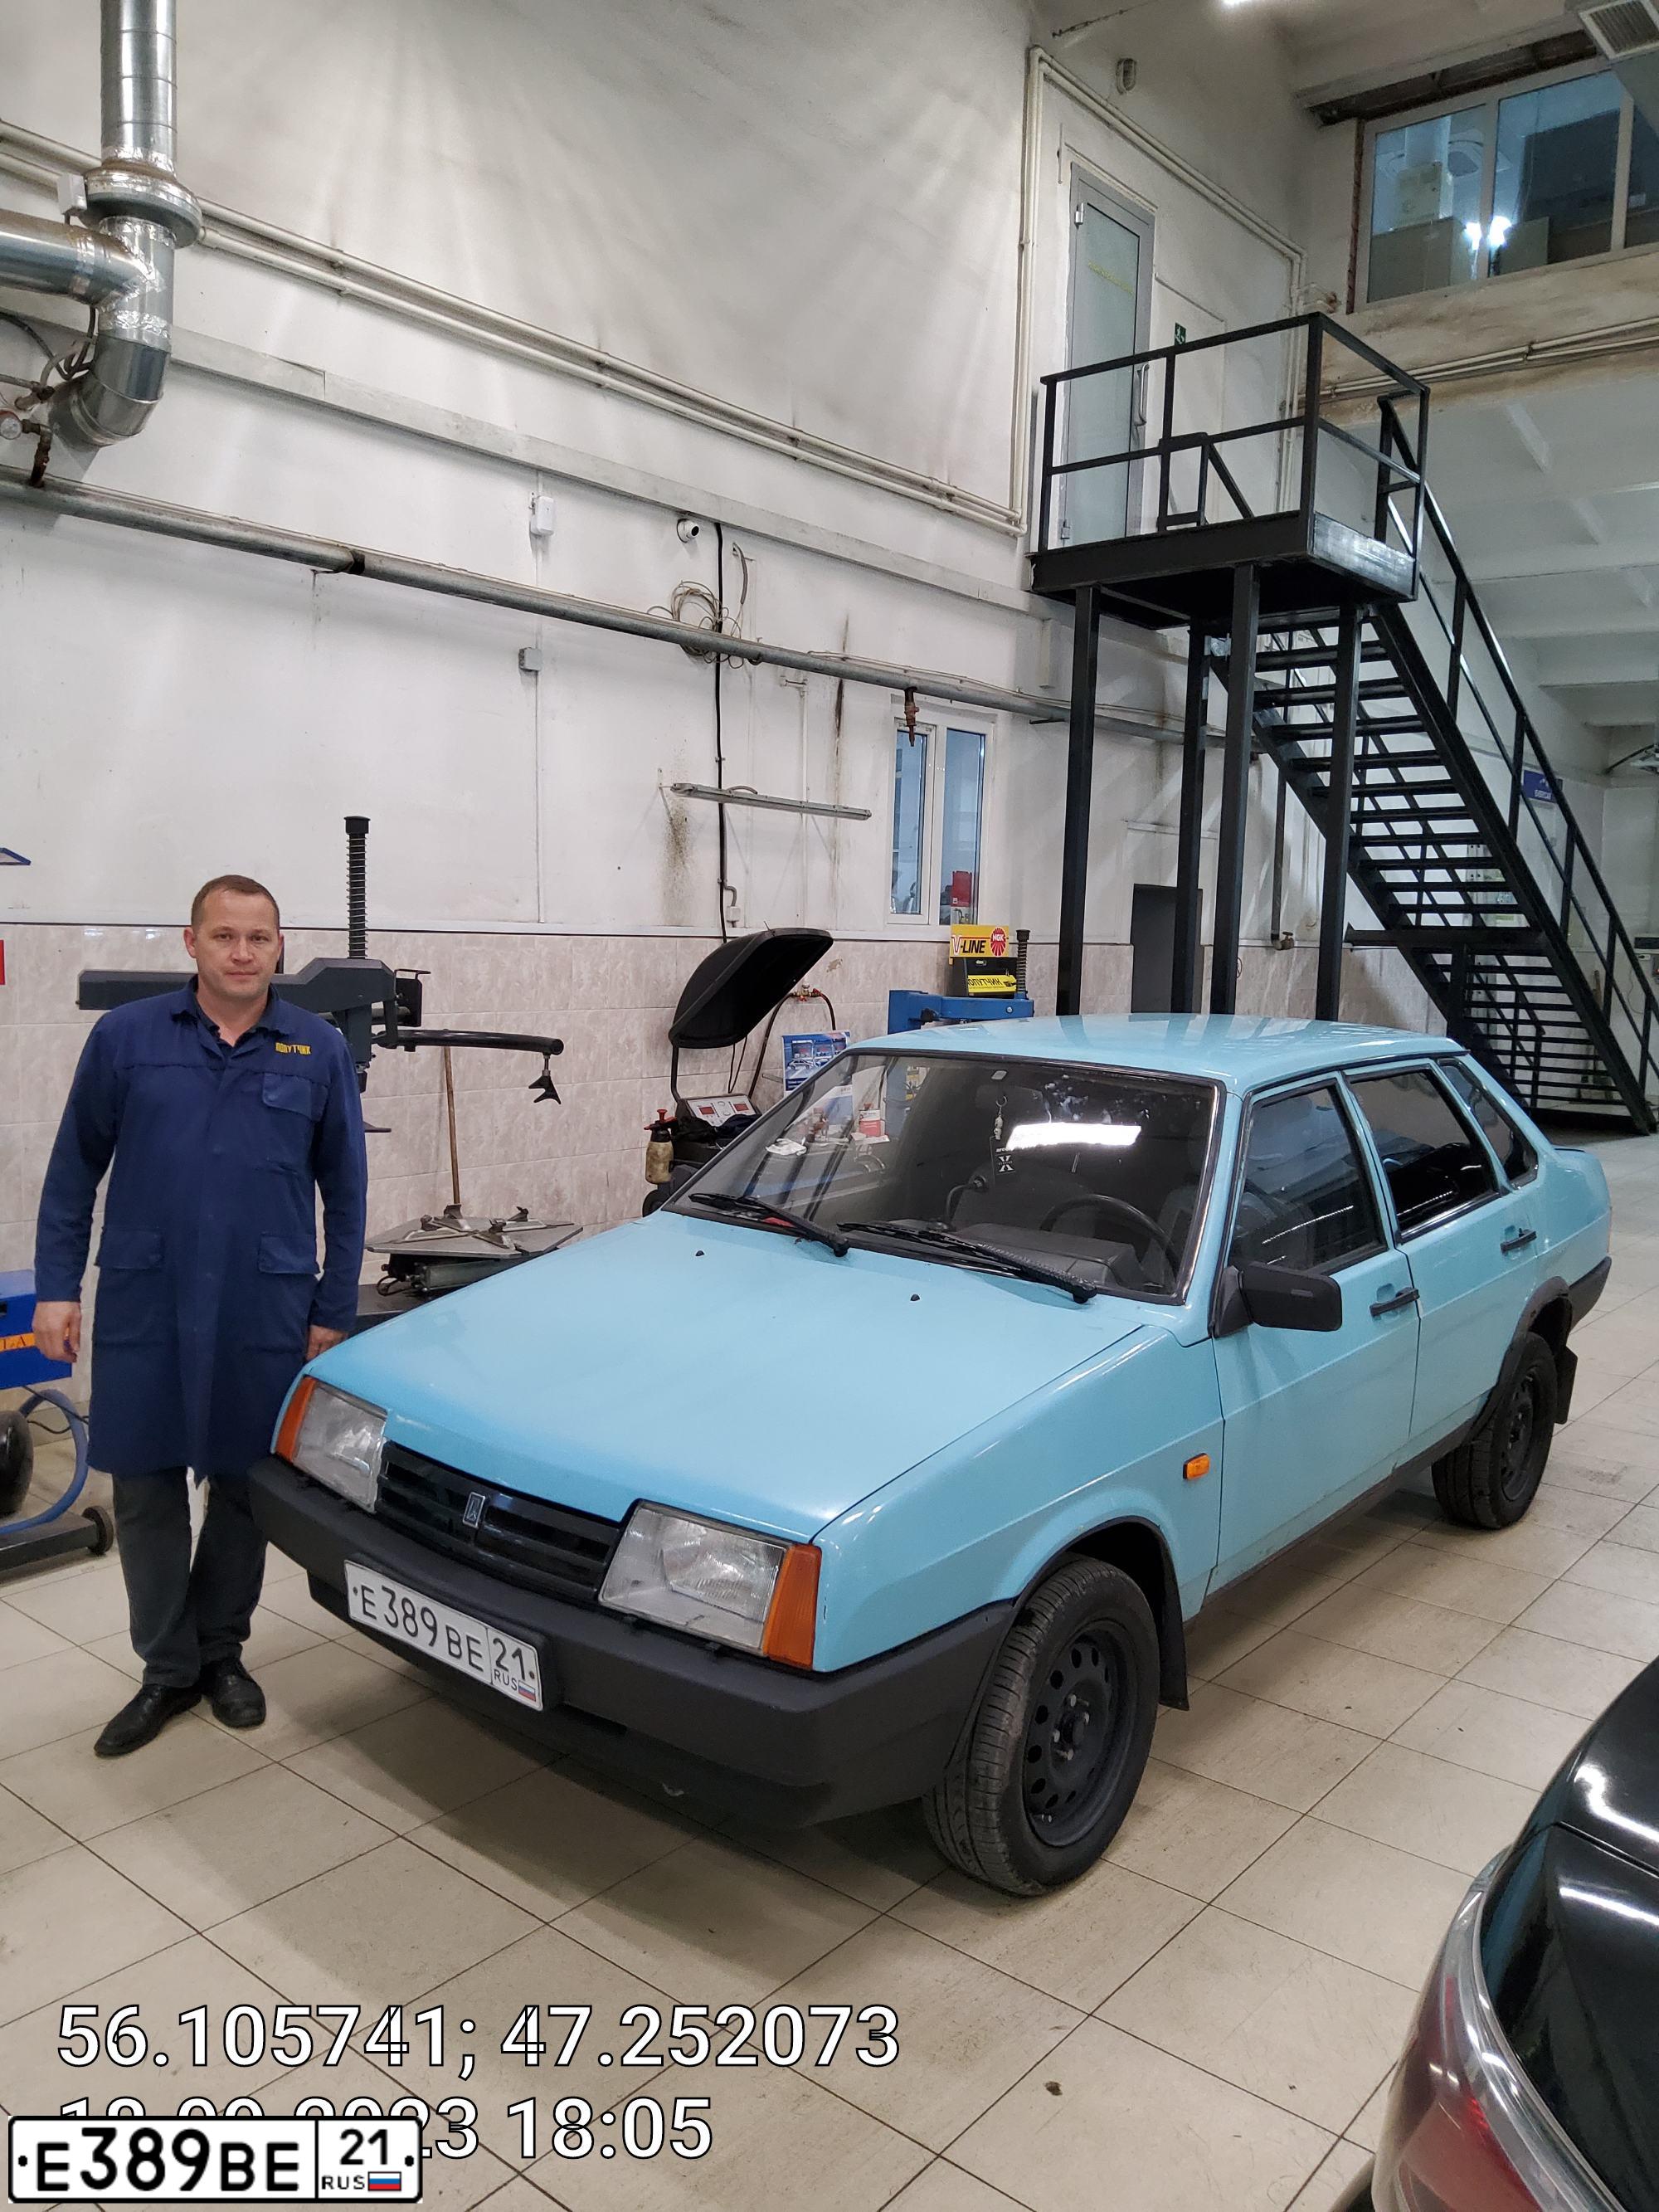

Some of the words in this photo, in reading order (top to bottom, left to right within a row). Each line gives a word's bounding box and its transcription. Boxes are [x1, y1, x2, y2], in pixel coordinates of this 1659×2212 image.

[992, 933, 1005, 942] NGK
[493, 1638, 527, 1680] 21
[494, 1670, 518, 1692] RUS
